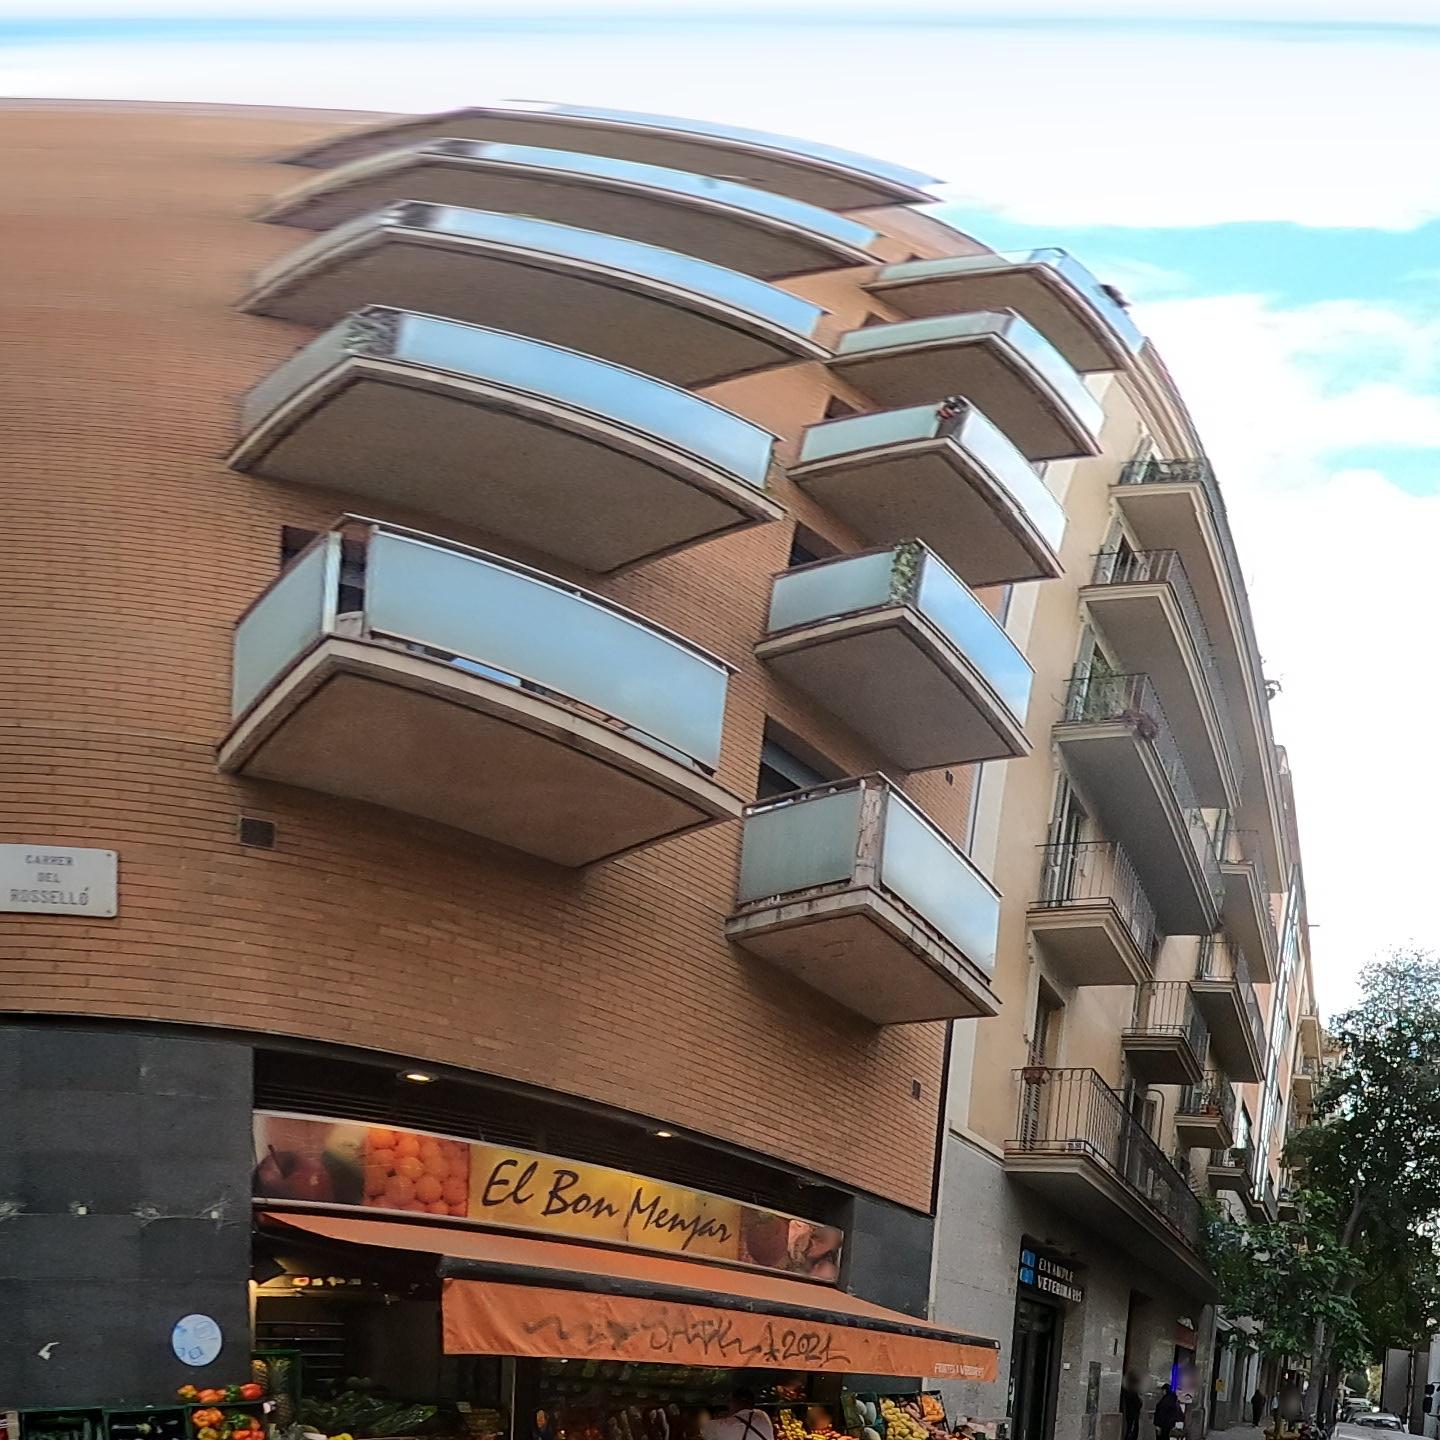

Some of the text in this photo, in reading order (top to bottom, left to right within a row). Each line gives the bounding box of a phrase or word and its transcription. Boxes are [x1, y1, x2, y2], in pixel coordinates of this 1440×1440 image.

[481, 1159, 733, 1251] El Bon Menjar
